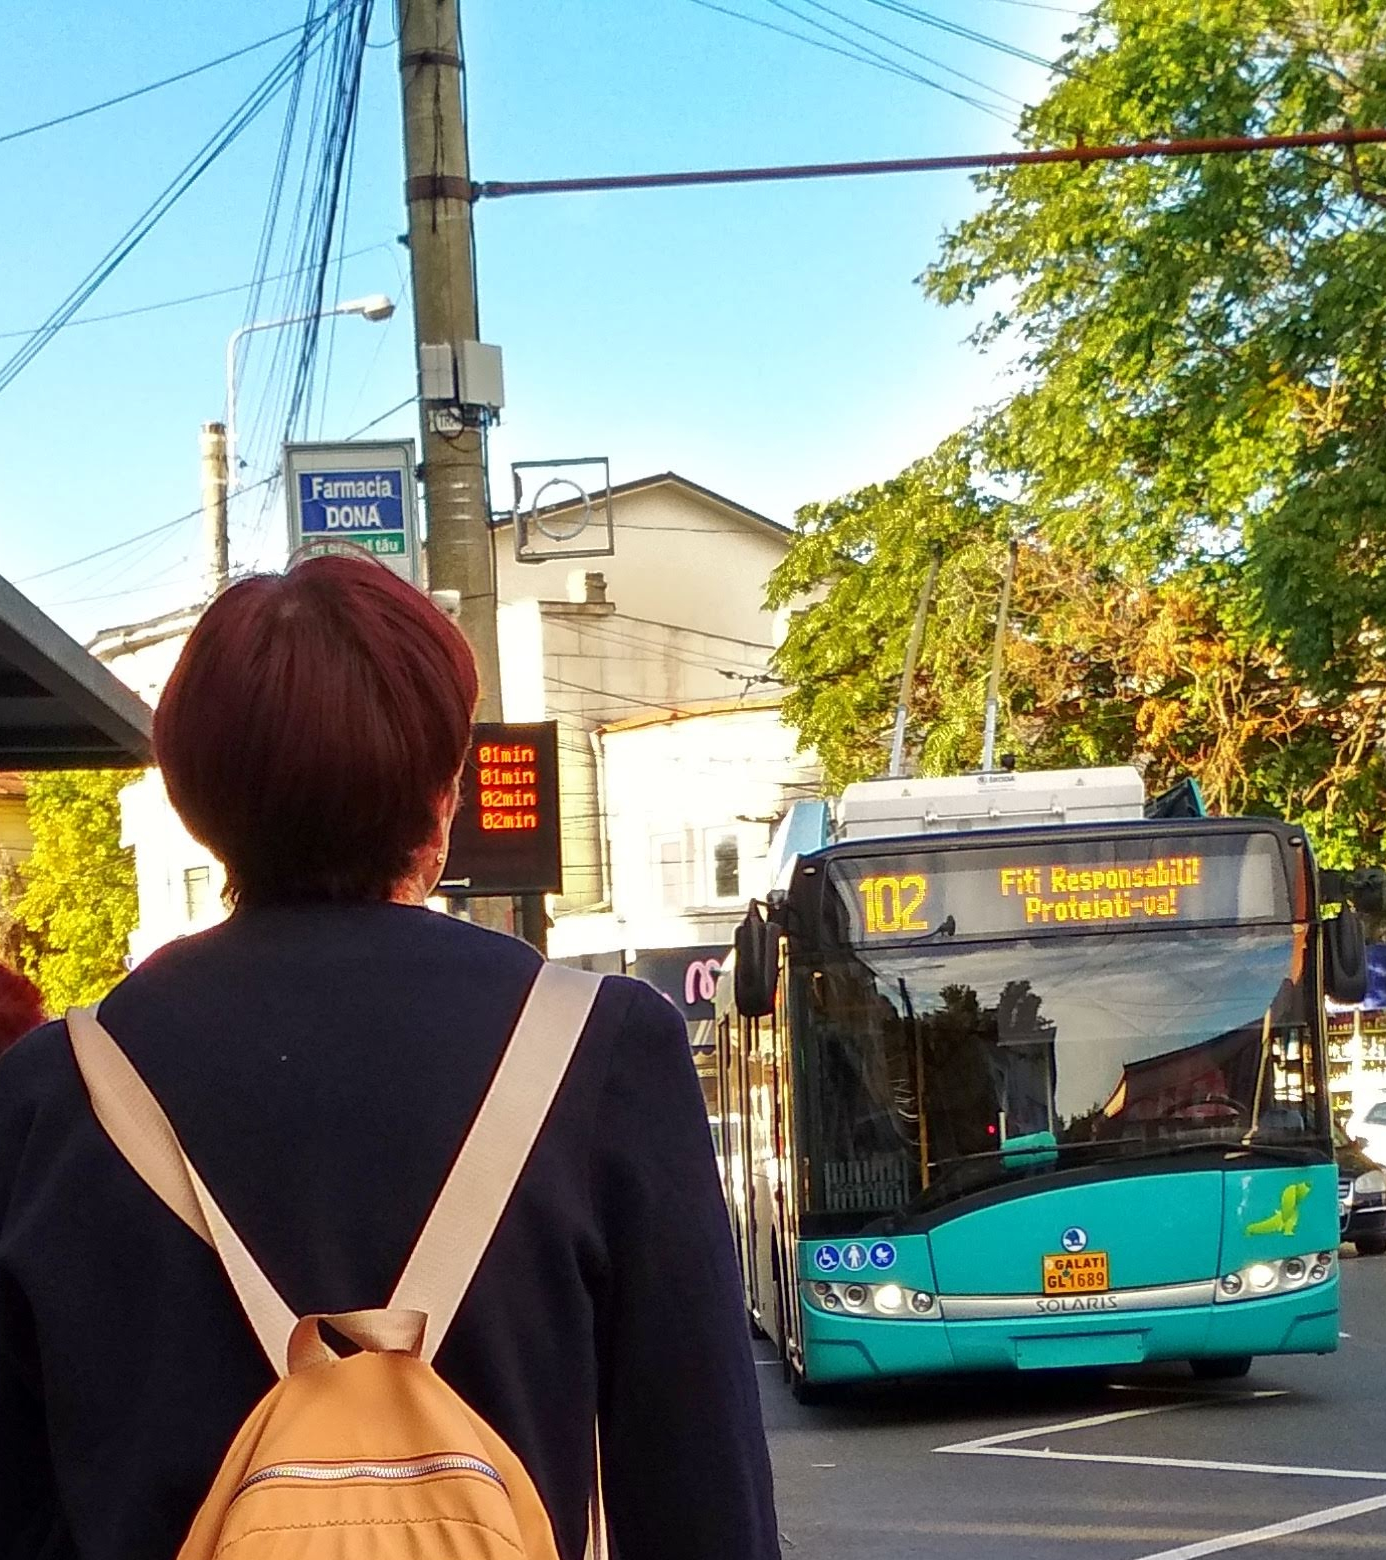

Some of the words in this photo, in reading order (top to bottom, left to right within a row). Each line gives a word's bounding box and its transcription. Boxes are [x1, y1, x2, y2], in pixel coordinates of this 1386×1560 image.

[310, 474, 392, 500] Farmacia
[325, 504, 382, 528] DONA
[479, 746, 535, 763] 01min
[480, 767, 536, 785] 01min
[481, 789, 536, 807] 02min
[482, 811, 537, 830] 02min
[1000, 868, 1041, 897] Fiti
[1051, 856, 1201, 893] Responsabili!
[859, 874, 928, 934] 102
[1055, 1257, 1105, 1271] GALATI
[1047, 1275, 1067, 1288] GL
[1070, 1271, 1105, 1288] 1689
[1036, 1295, 1118, 1313] SOLARIS
